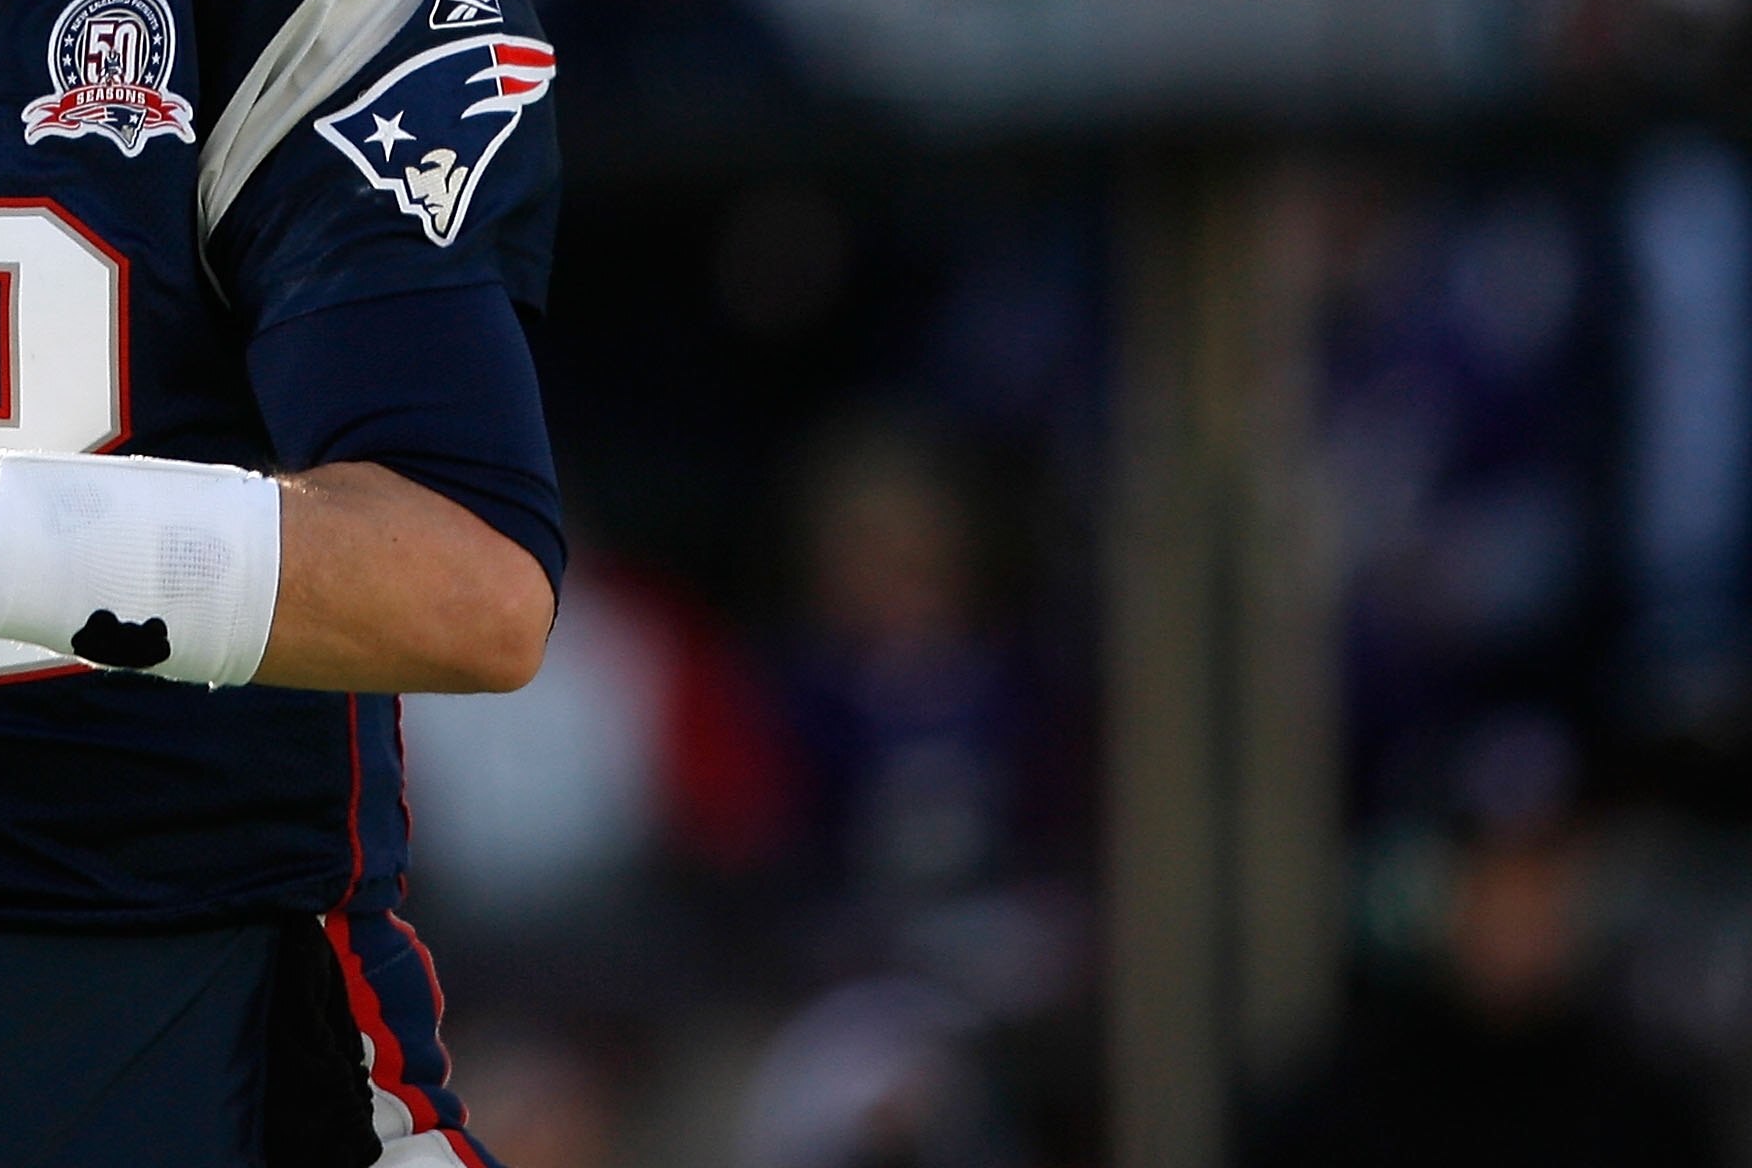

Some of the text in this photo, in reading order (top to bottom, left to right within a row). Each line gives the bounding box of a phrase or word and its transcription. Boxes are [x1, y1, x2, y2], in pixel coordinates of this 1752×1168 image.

[70, 9, 89, 31] NEW
[85, 19, 140, 86] 50
[76, 86, 146, 106] SEASONS
